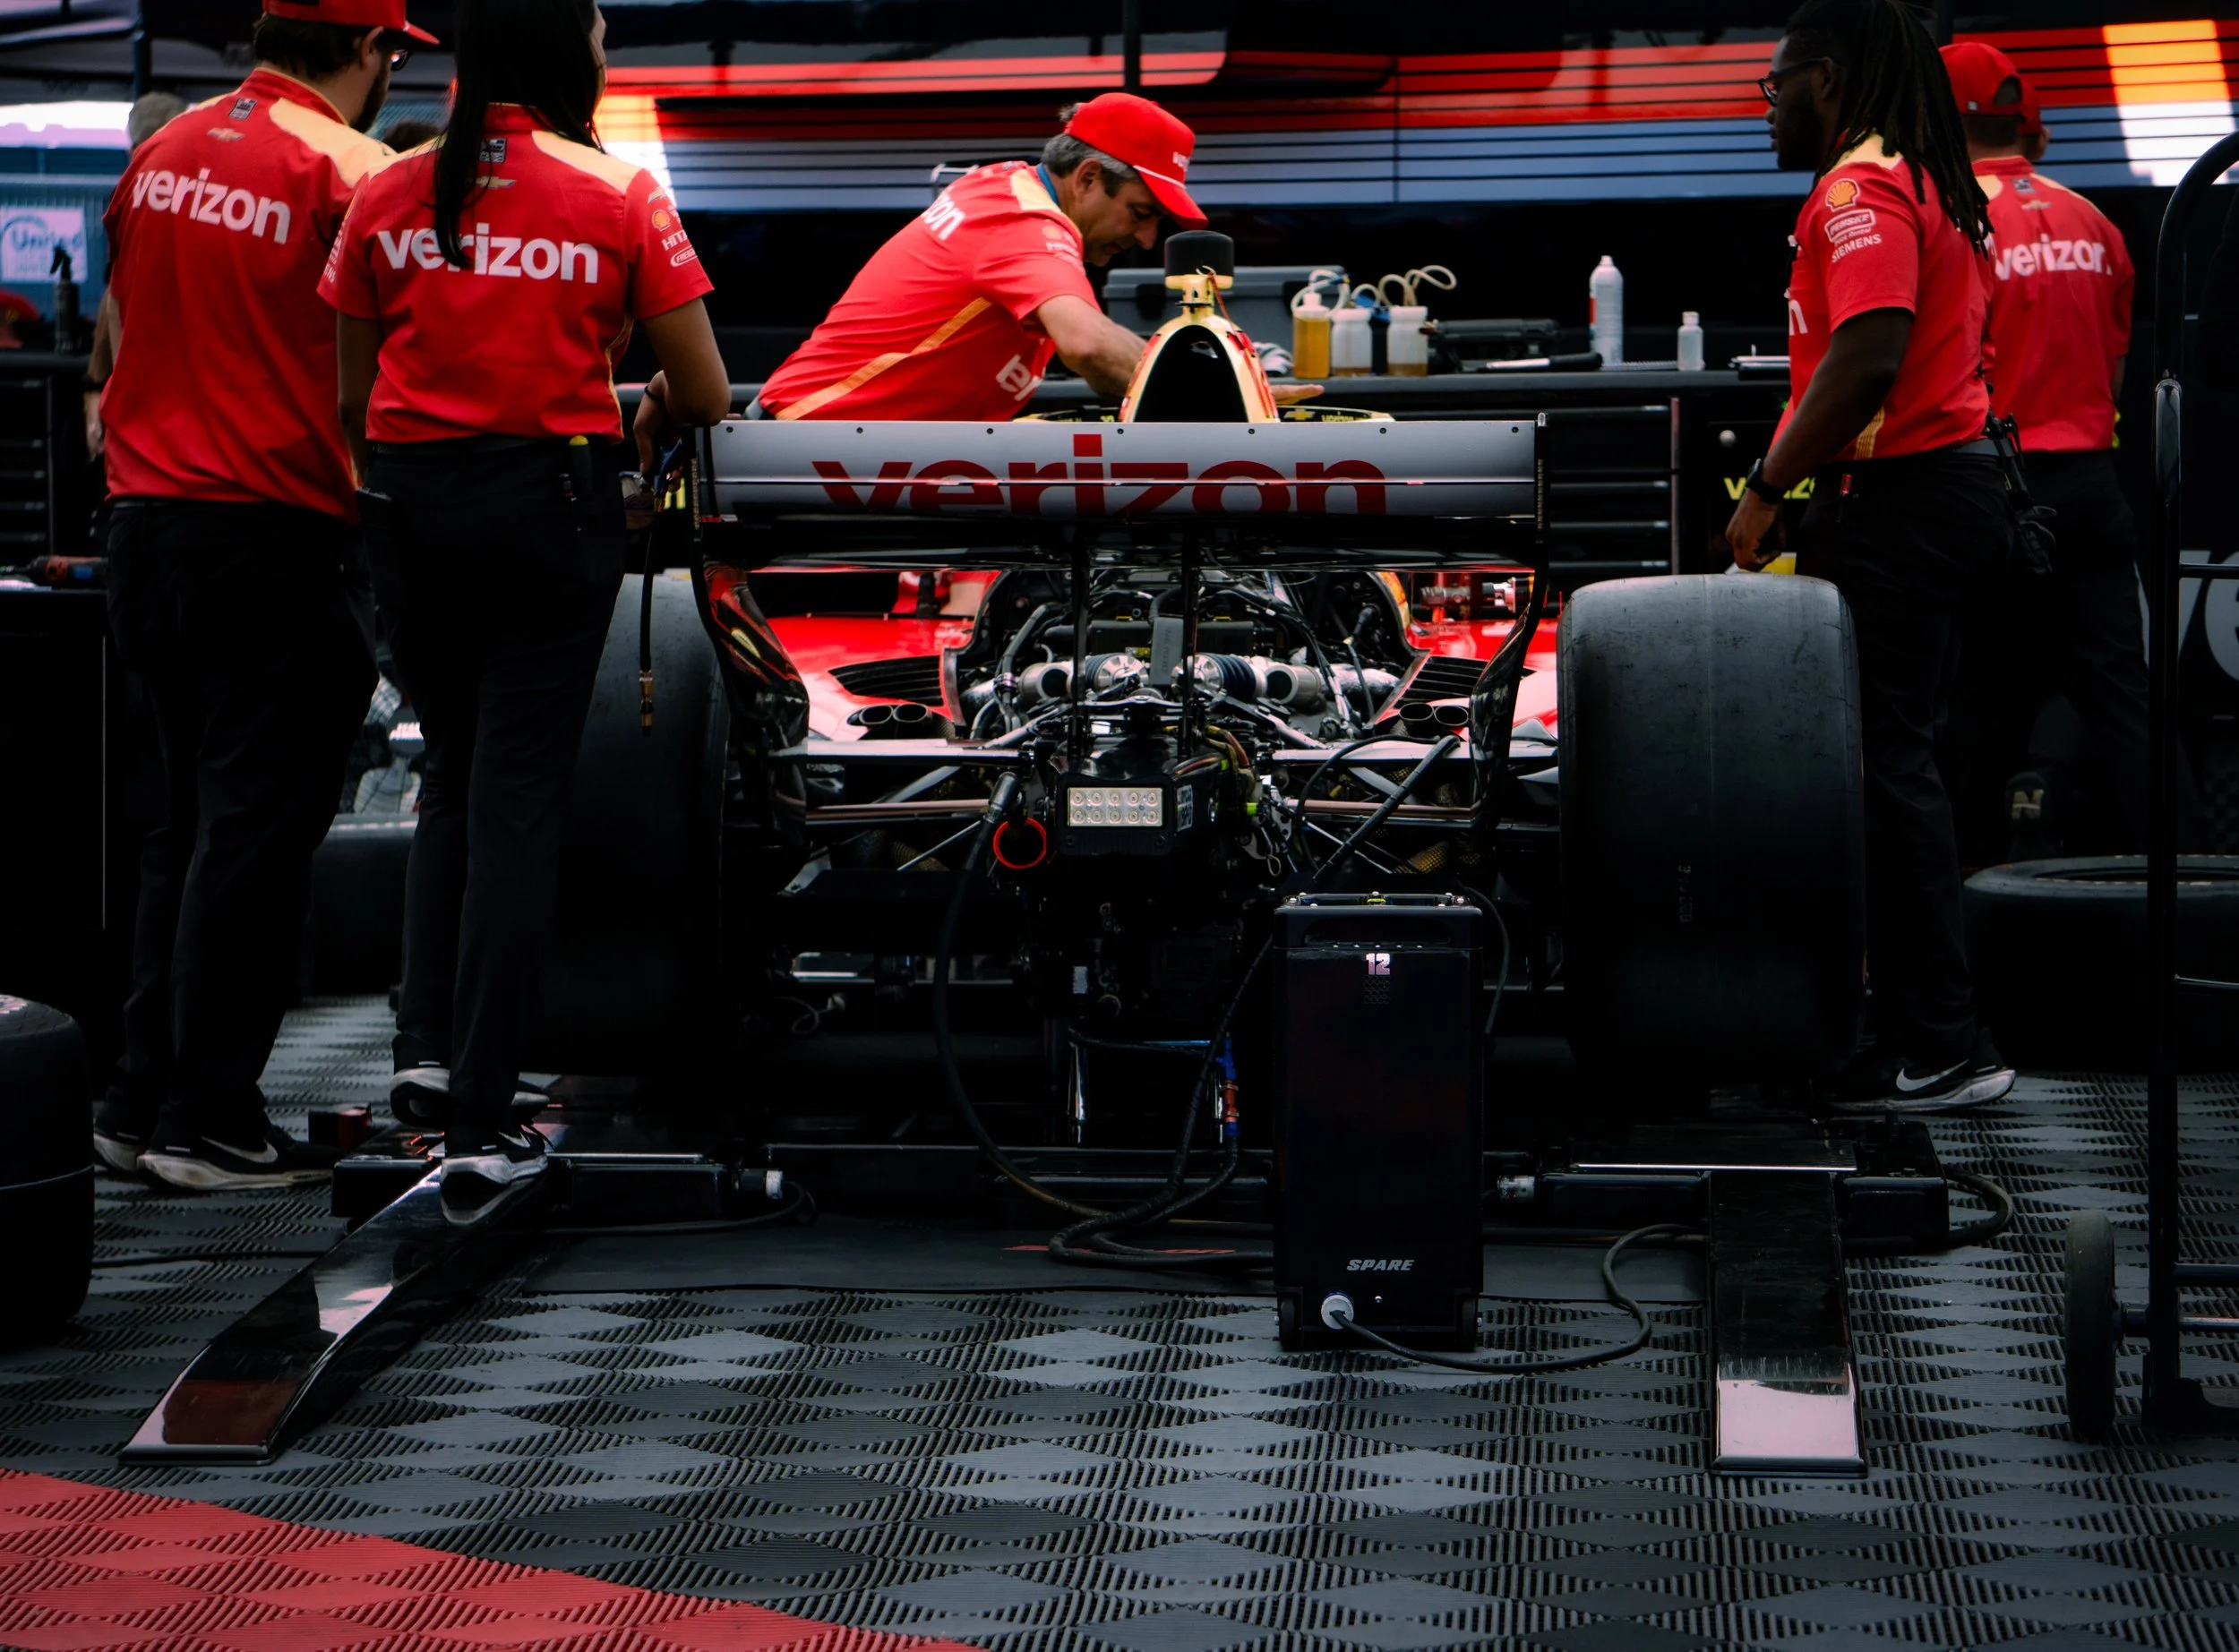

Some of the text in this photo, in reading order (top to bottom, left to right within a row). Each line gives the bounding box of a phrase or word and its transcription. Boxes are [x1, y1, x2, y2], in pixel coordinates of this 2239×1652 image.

[133, 167, 292, 246] verizon
[1832, 234, 1883, 263] SIEMENS
[812, 434, 1386, 518] verizon
[1365, 953, 1391, 976] 12
[1346, 1259, 1415, 1271] SPARE
